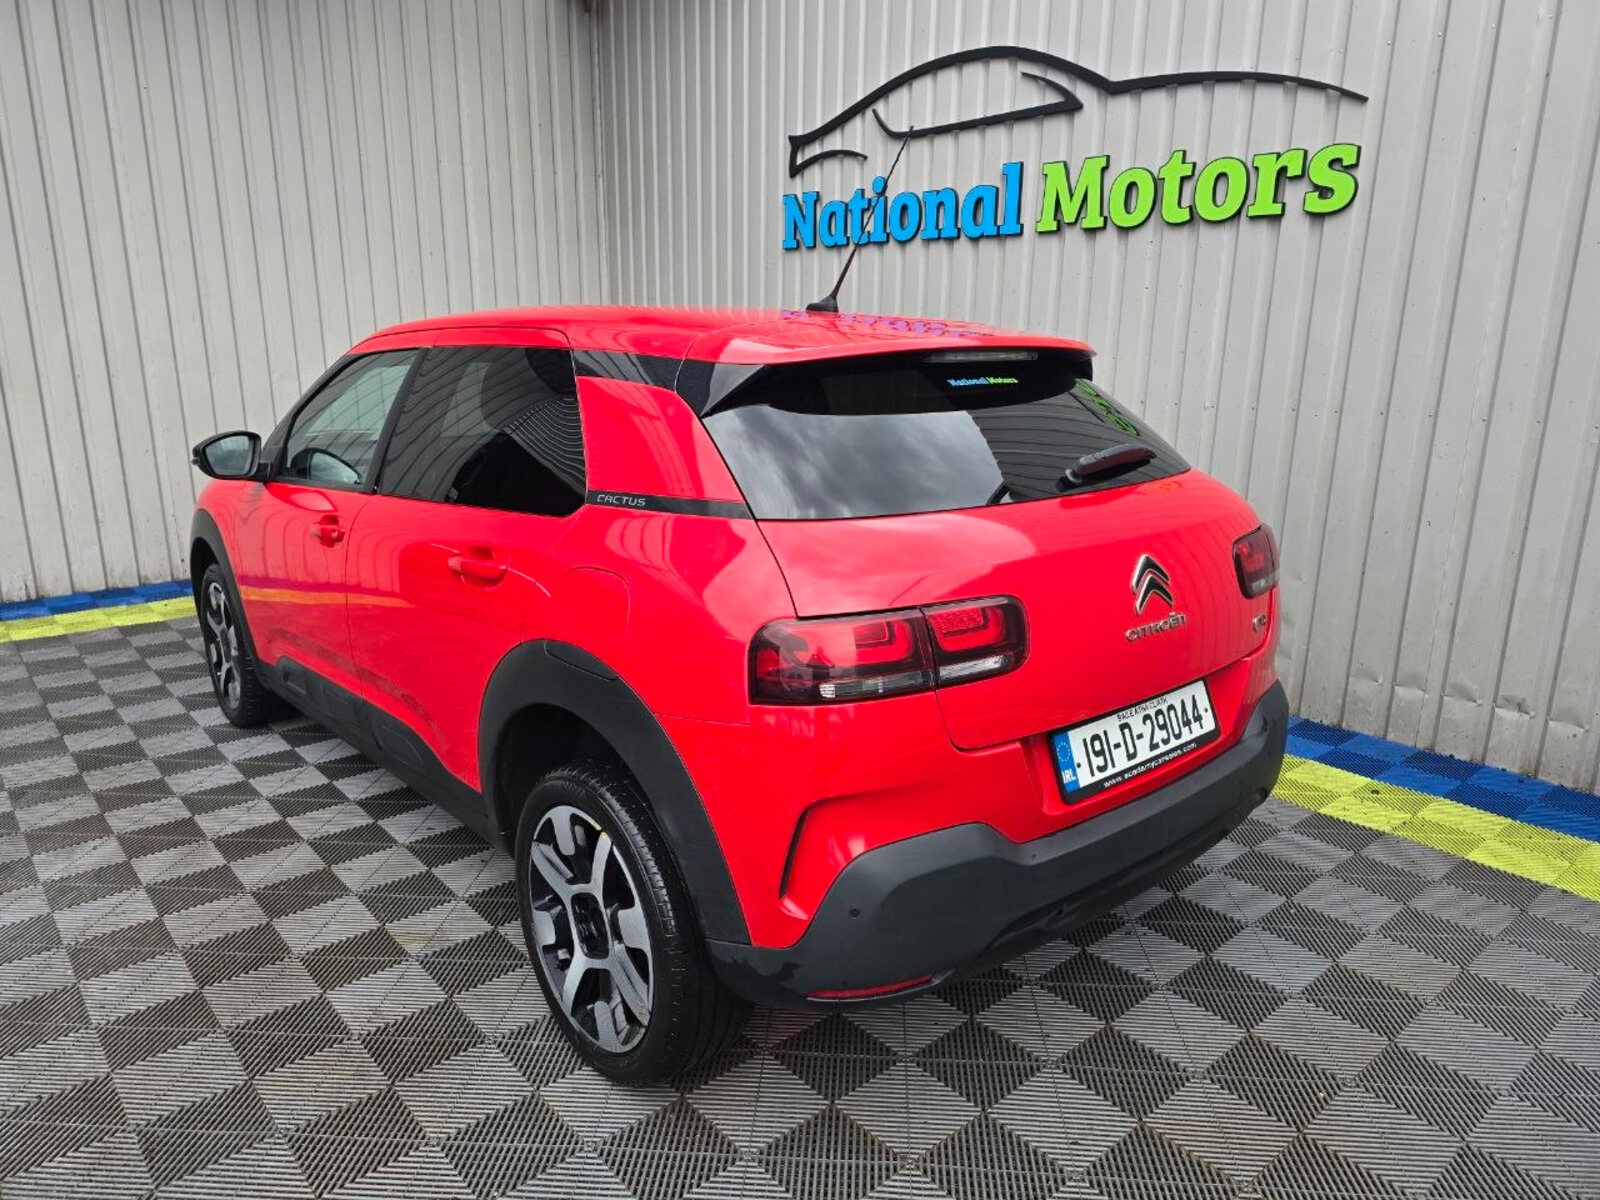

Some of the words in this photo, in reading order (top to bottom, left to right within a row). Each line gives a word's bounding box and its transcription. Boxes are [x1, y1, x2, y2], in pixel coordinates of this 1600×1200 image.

[782, 160, 1024, 250] National
[1035, 142, 1363, 234] Motors
[596, 494, 646, 507] CACTUS
[1125, 611, 1186, 642] CITROËN
[1082, 694, 1204, 778] 191-D-29044
[1061, 769, 1077, 785] IRL
